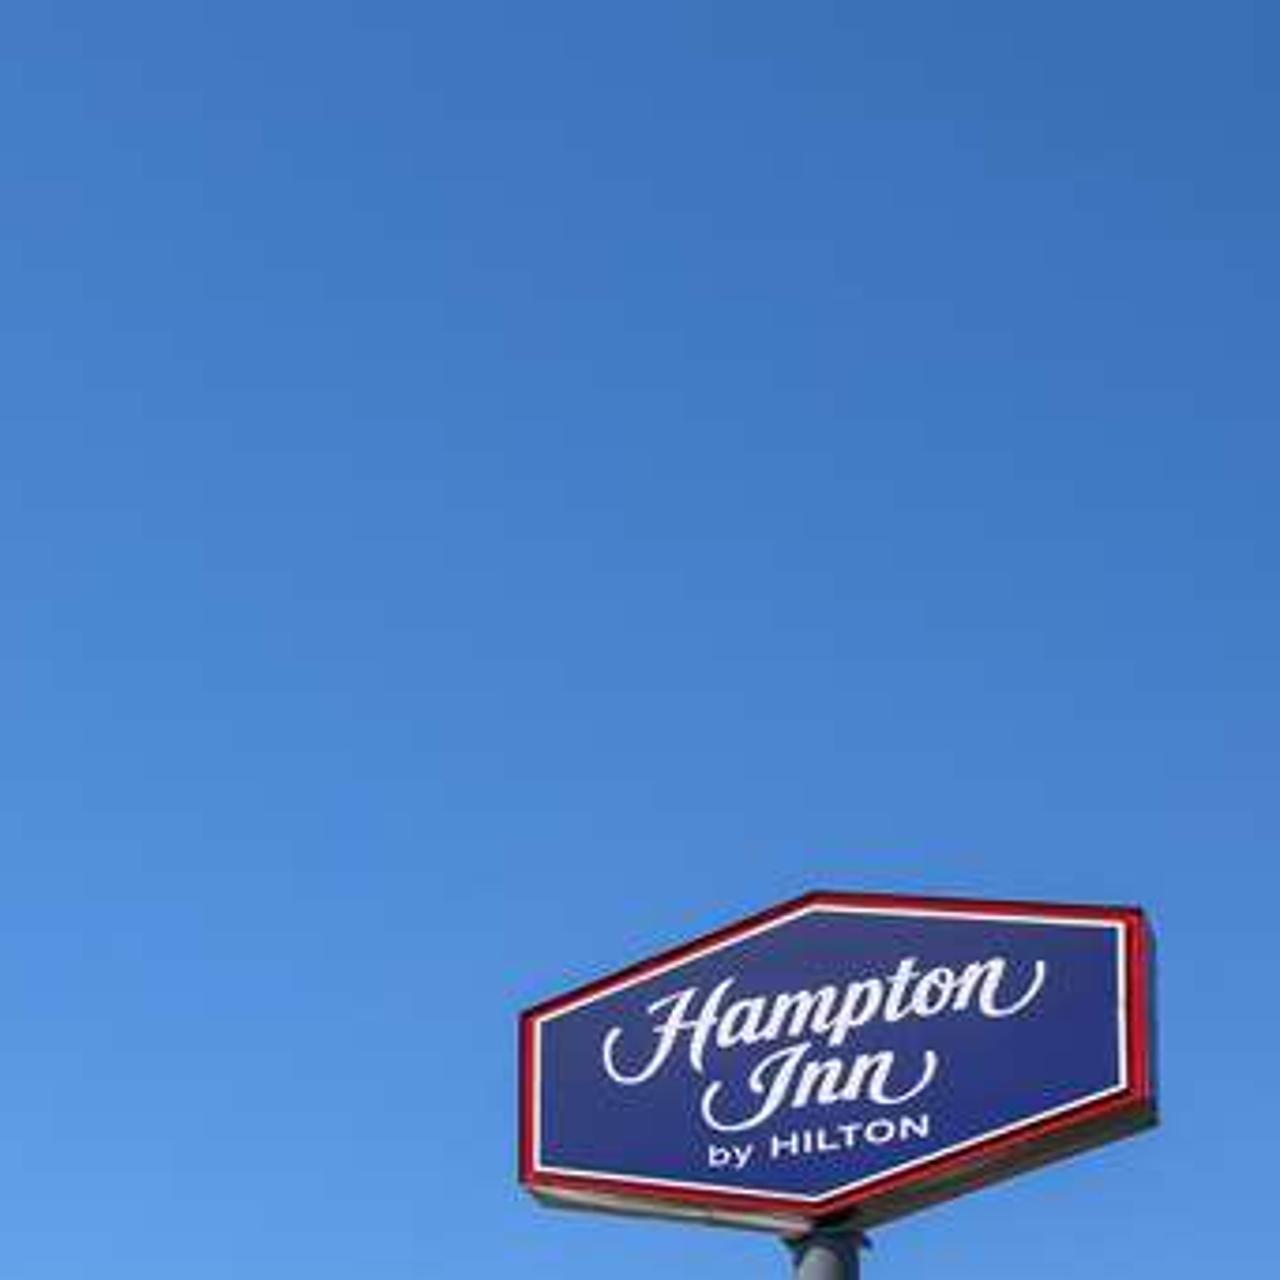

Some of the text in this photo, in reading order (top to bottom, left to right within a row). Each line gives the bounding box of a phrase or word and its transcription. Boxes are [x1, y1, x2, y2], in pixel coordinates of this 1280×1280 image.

[603, 957, 1045, 1084] Hampton
[702, 1041, 937, 1132] Inn
[708, 1114, 929, 1169] by HILTON
